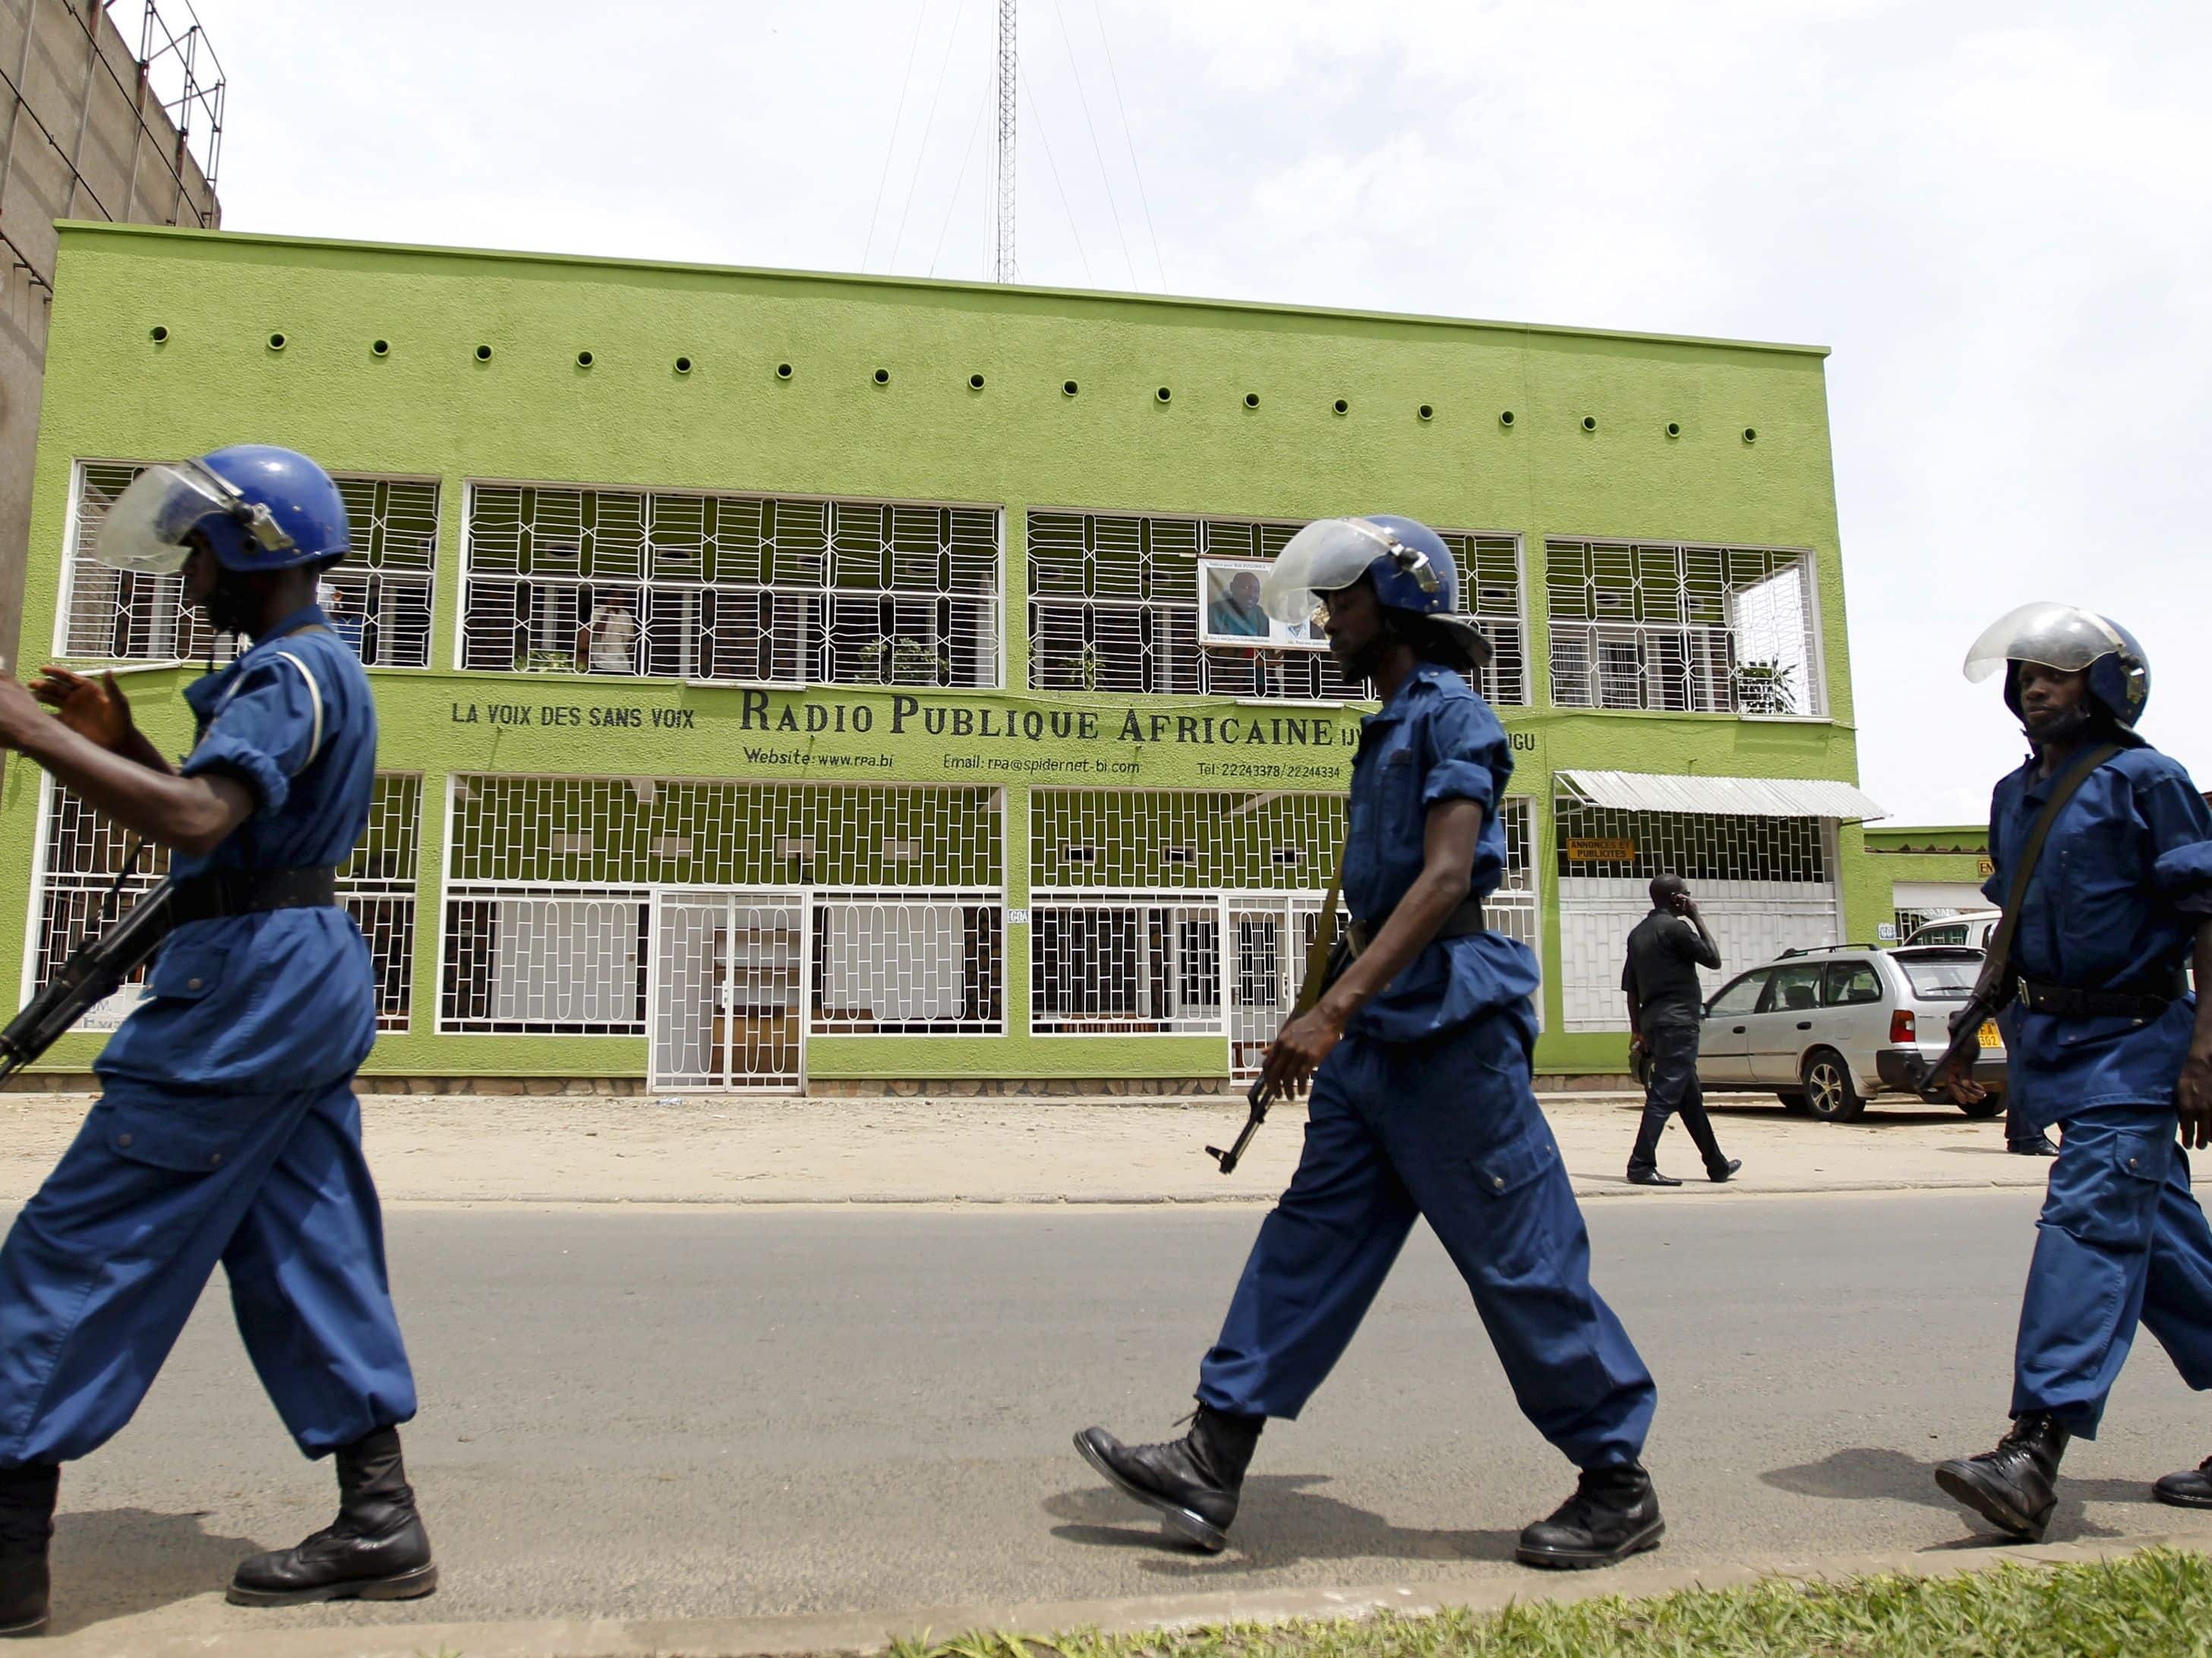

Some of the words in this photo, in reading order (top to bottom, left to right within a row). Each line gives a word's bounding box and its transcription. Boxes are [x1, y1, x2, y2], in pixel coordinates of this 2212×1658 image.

[452, 703, 478, 723] LA
[488, 704, 532, 725] VOIX
[541, 706, 581, 727] DES
[588, 707, 642, 728] SANS
[651, 708, 694, 729] VOIX
[943, 753, 985, 770] Email:
[1571, 840, 1617, 849] ANNONCES
